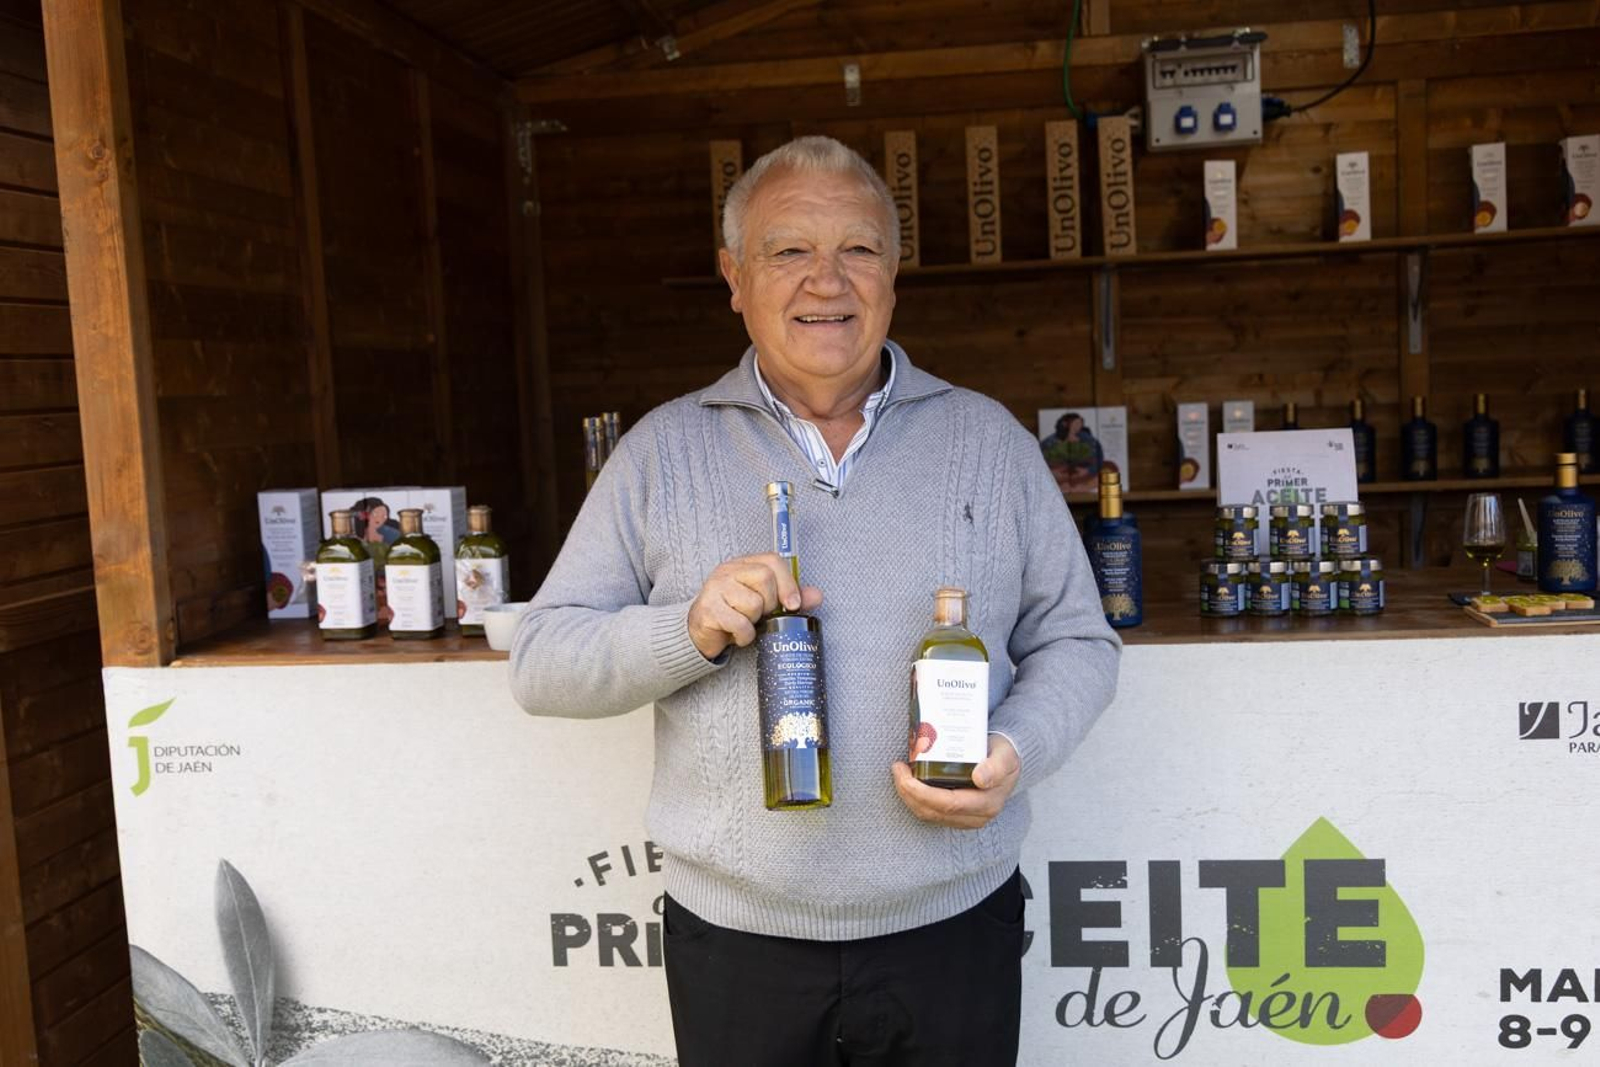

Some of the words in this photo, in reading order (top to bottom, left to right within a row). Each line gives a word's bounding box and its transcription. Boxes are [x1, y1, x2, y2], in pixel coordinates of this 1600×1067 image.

[892, 152, 915, 261] UnOlivo
[974, 147, 996, 258] UnOlivo
[1053, 142, 1076, 253] UnOlivo
[1106, 137, 1132, 250] UnOlivo
[1252, 487, 1328, 505] ACEITE
[1266, 477, 1308, 487] PRIMER
[773, 640, 818, 652] UnOlivo
[937, 678, 977, 689] UnOlivo
[154, 743, 241, 757] DIPUTACIÓN
[155, 762, 174, 774] DE
[177, 760, 212, 773] JAÉN
[1020, 859, 1386, 968] EITE
[550, 913, 663, 967] PRI
[1055, 966, 1147, 1028] de
[1153, 936, 1352, 1060] Jaén
[1500, 968, 1600, 1002] MA
[1498, 1014, 1591, 1049] 8-9
